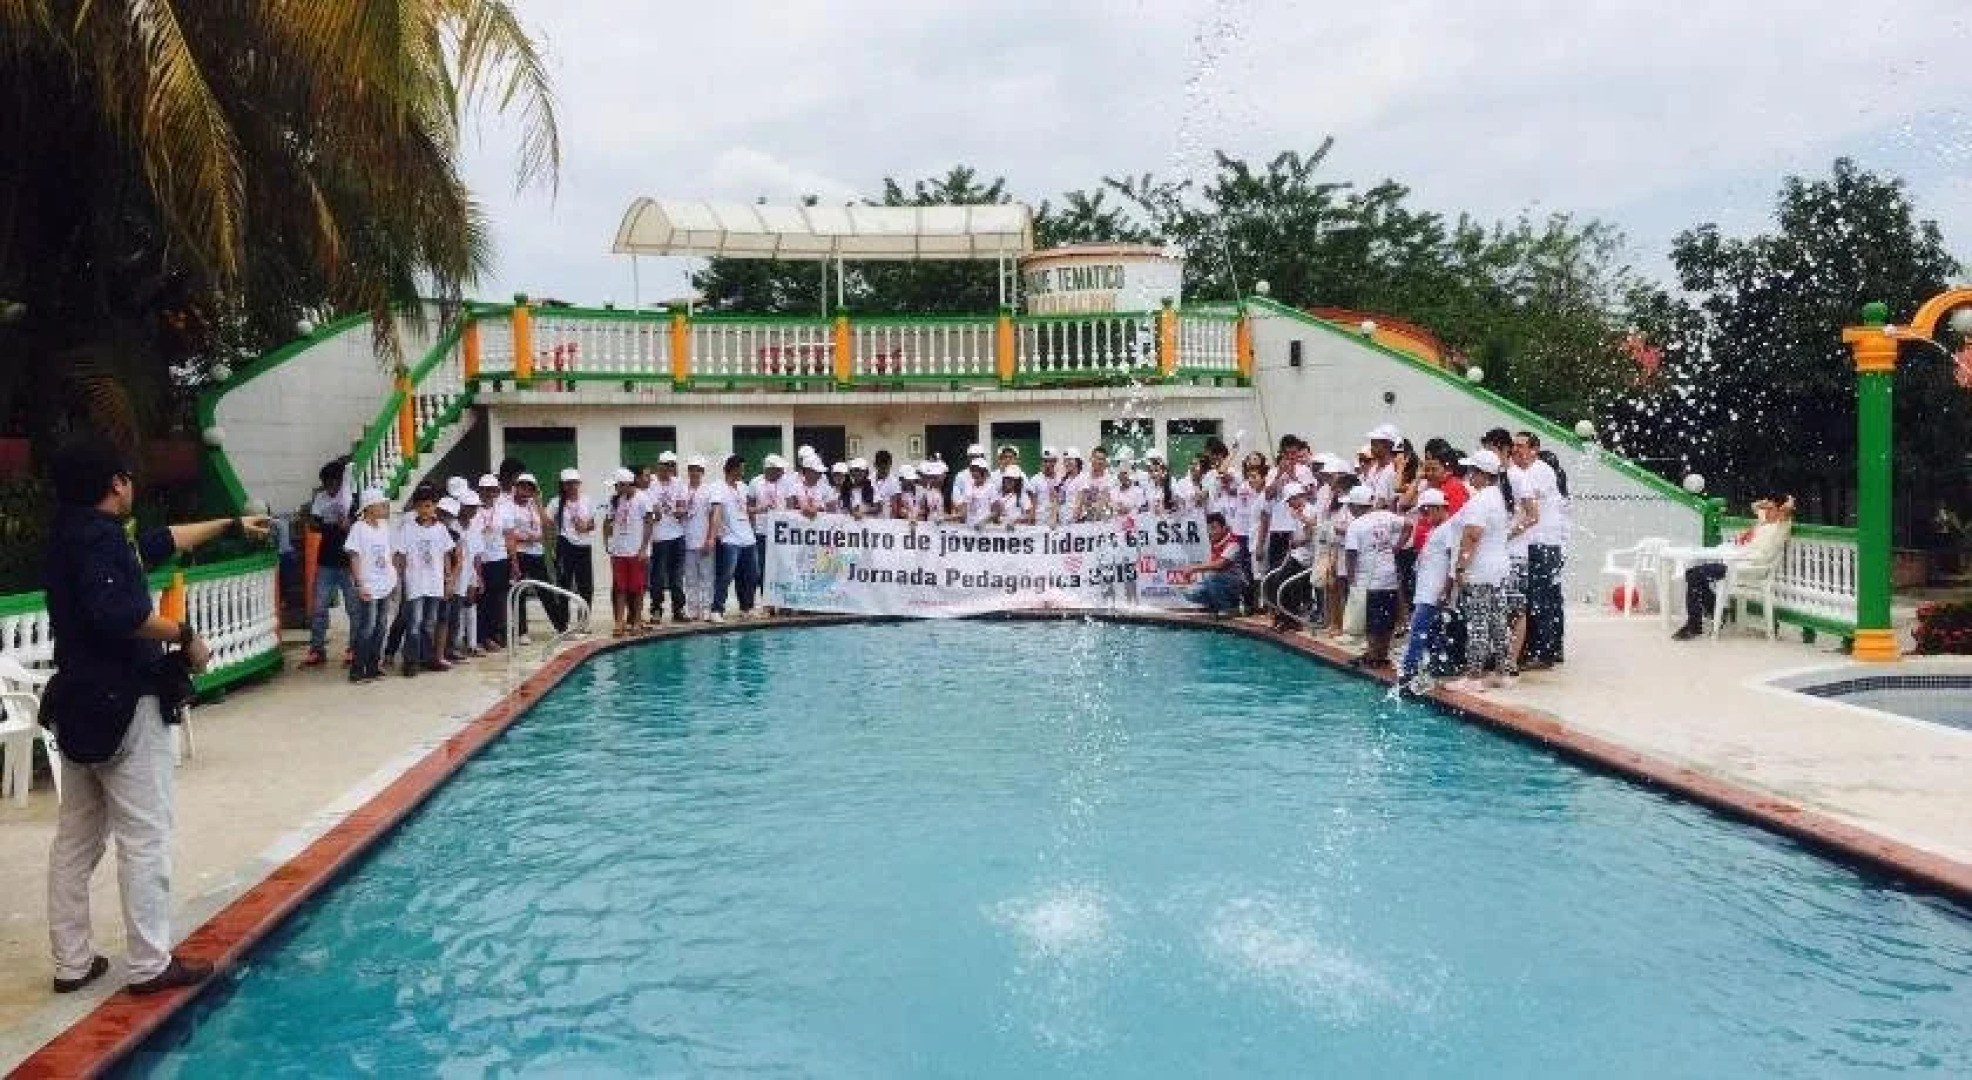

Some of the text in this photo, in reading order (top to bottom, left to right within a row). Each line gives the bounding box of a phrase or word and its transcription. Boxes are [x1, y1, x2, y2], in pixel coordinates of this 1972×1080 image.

[774, 521, 895, 550] Encuentro
[904, 527, 931, 550] de
[938, 530, 1034, 557] jóvenes
[847, 563, 938, 586] Jornada
